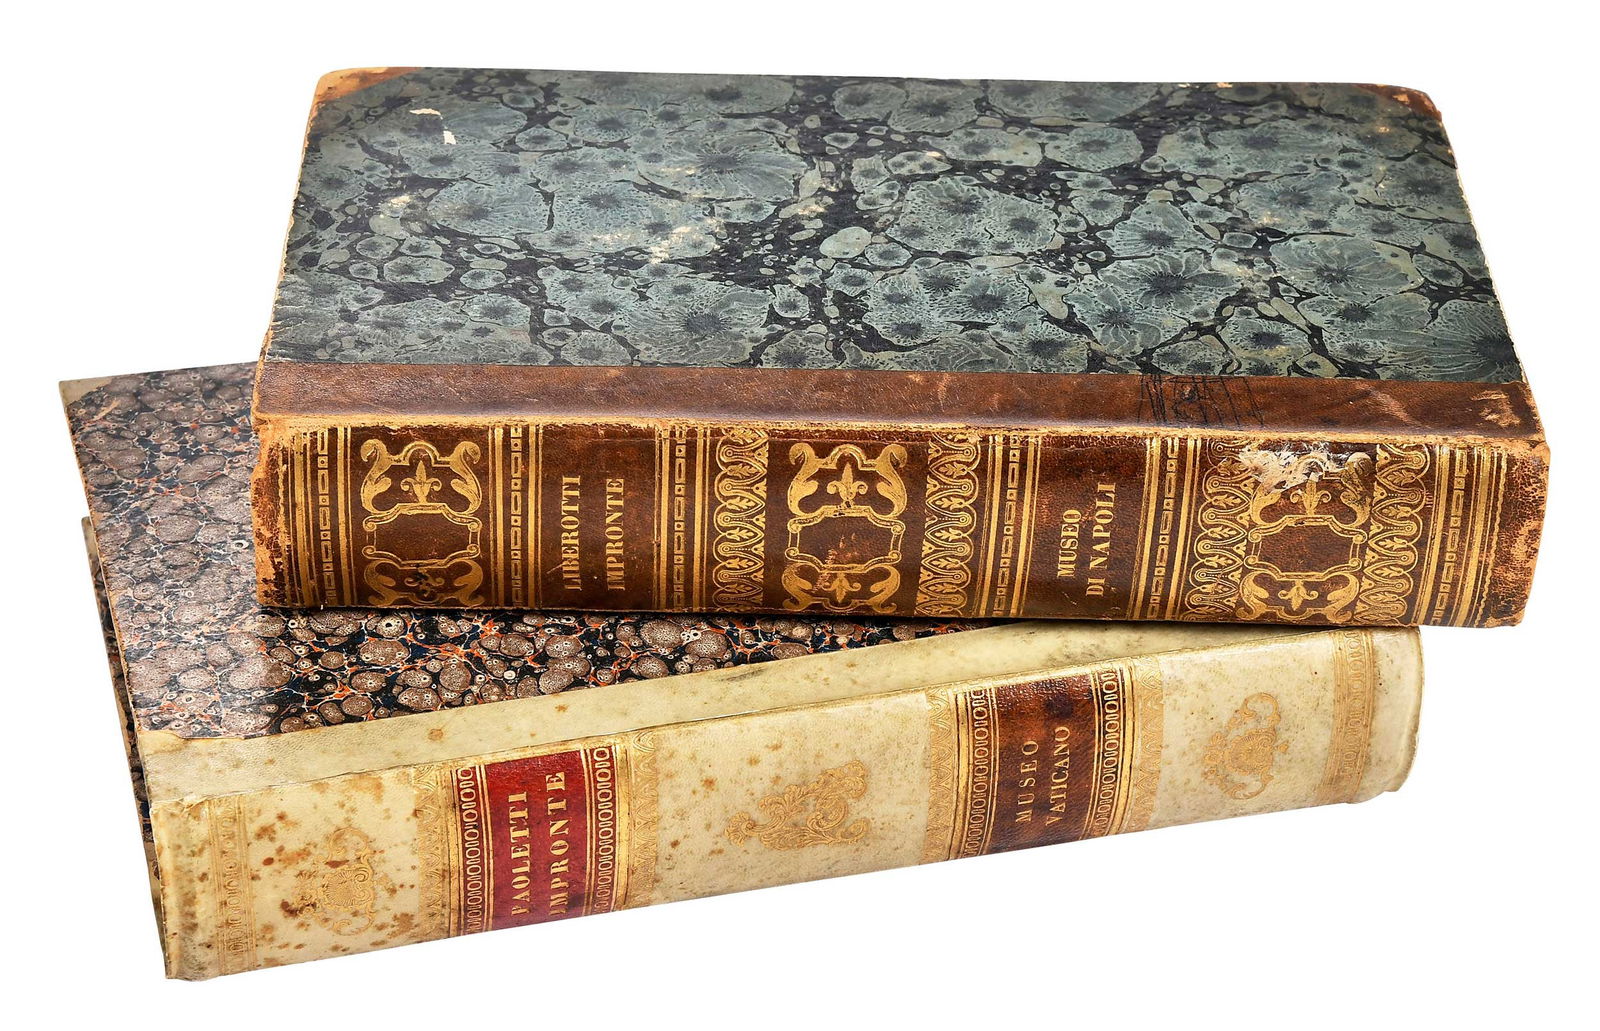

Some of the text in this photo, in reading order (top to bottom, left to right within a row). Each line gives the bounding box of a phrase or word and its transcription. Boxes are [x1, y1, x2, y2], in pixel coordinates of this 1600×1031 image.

[561, 475, 582, 591] LIBEROTTI
[605, 478, 625, 591] IMPRONTE
[1057, 509, 1081, 578] MUSEO
[1086, 482, 1116, 597] DI NAPOLI
[1015, 740, 1039, 823] MUSEO
[1045, 726, 1071, 826] VATICANO
[508, 791, 531, 916] PAOLETTI
[545, 771, 569, 916] IMPRONTE
